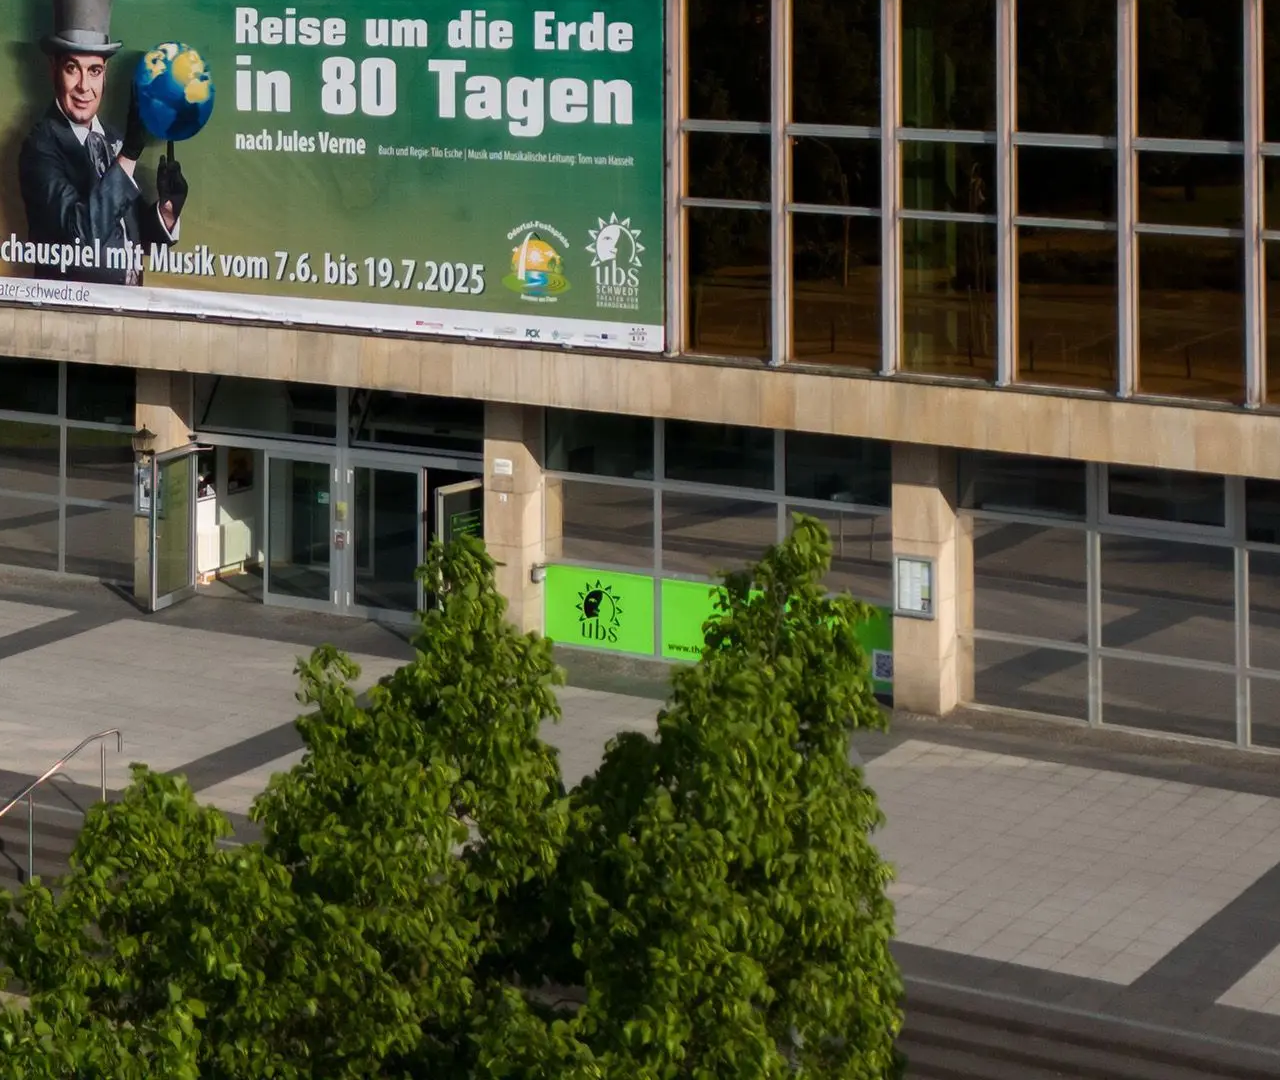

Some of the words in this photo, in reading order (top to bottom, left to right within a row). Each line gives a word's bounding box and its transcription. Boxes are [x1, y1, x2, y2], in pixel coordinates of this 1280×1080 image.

[235, 7, 347, 46] Reise
[365, 18, 428, 47] um
[447, 10, 514, 50] die
[534, 11, 633, 52] Erde
[235, 55, 291, 112] in
[321, 56, 397, 117] 80
[428, 59, 633, 137] Tagen
[235, 128, 273, 151] nach
[275, 130, 316, 153] Jules
[318, 132, 366, 155] Verne
[378, 145, 395, 156] Buch
[396, 146, 409, 156] und
[467, 149, 488, 160] Musik
[489, 150, 503, 161] und
[504, 151, 547, 163] Musikalische
[106, 239, 145, 271] mit
[149, 242, 215, 277] Musik
[220, 252, 269, 280] vom
[275, 251, 319, 284] 7.6.
[324, 252, 359, 287] bis
[364, 256, 486, 295] 19.7.2025
[596, 260, 640, 288] ubs
[596, 285, 639, 297] SCHWEDT
[581, 618, 618, 644] ubs
